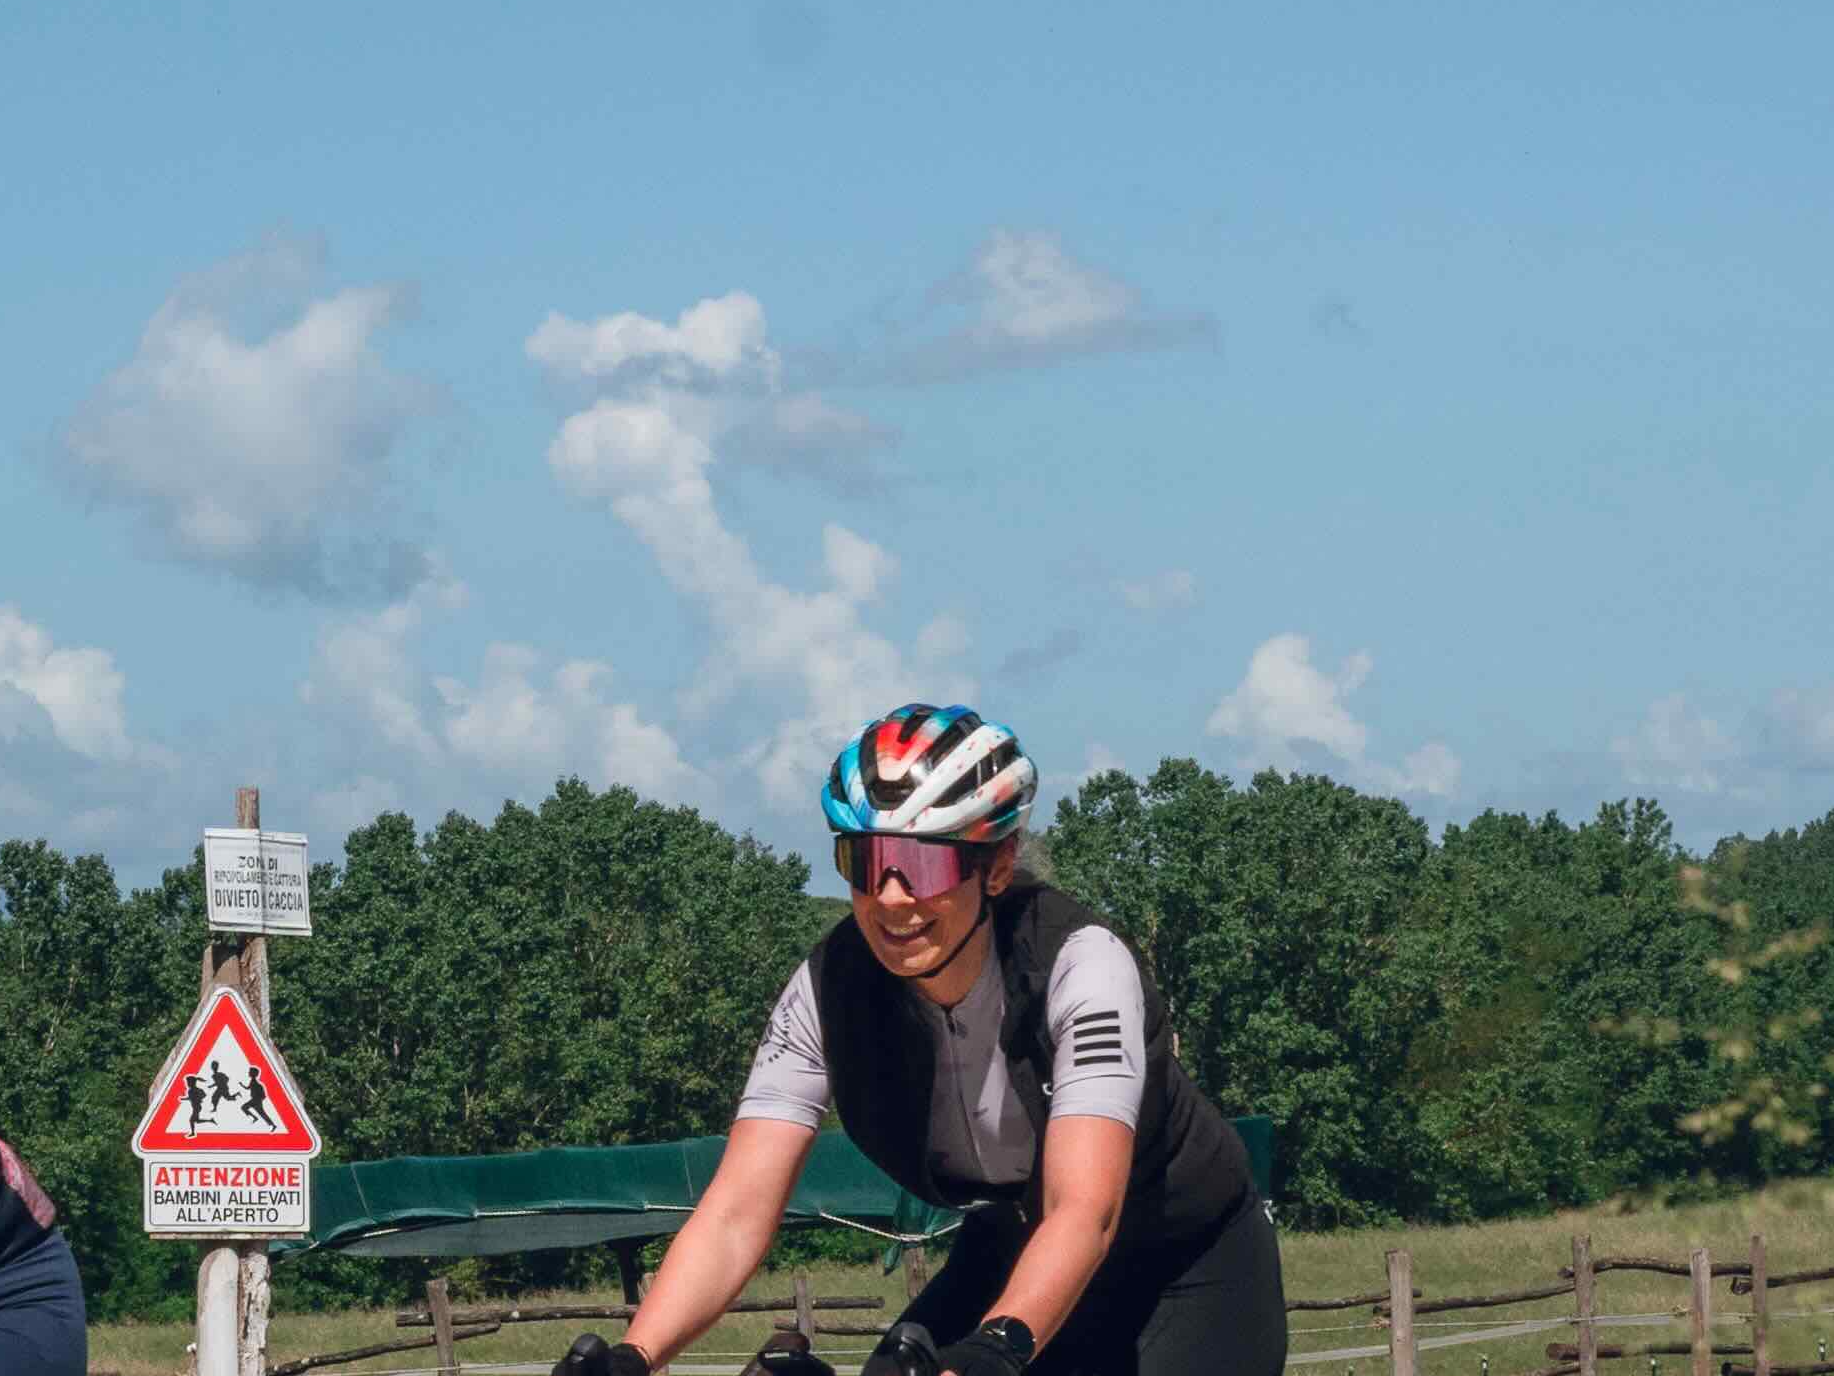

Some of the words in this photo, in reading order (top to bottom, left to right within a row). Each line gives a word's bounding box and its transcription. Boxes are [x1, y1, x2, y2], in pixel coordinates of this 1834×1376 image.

[238, 855, 265, 870] ZON
[268, 857, 278, 870] DI
[215, 889, 260, 908] DIVIETO
[268, 891, 303, 912] CACCIA
[154, 1167, 301, 1186] ATTENZIONE
[154, 1190, 221, 1205] BAMBINI
[228, 1190, 301, 1205] ALLEVATI
[176, 1207, 279, 1222] ALL'APERTO
